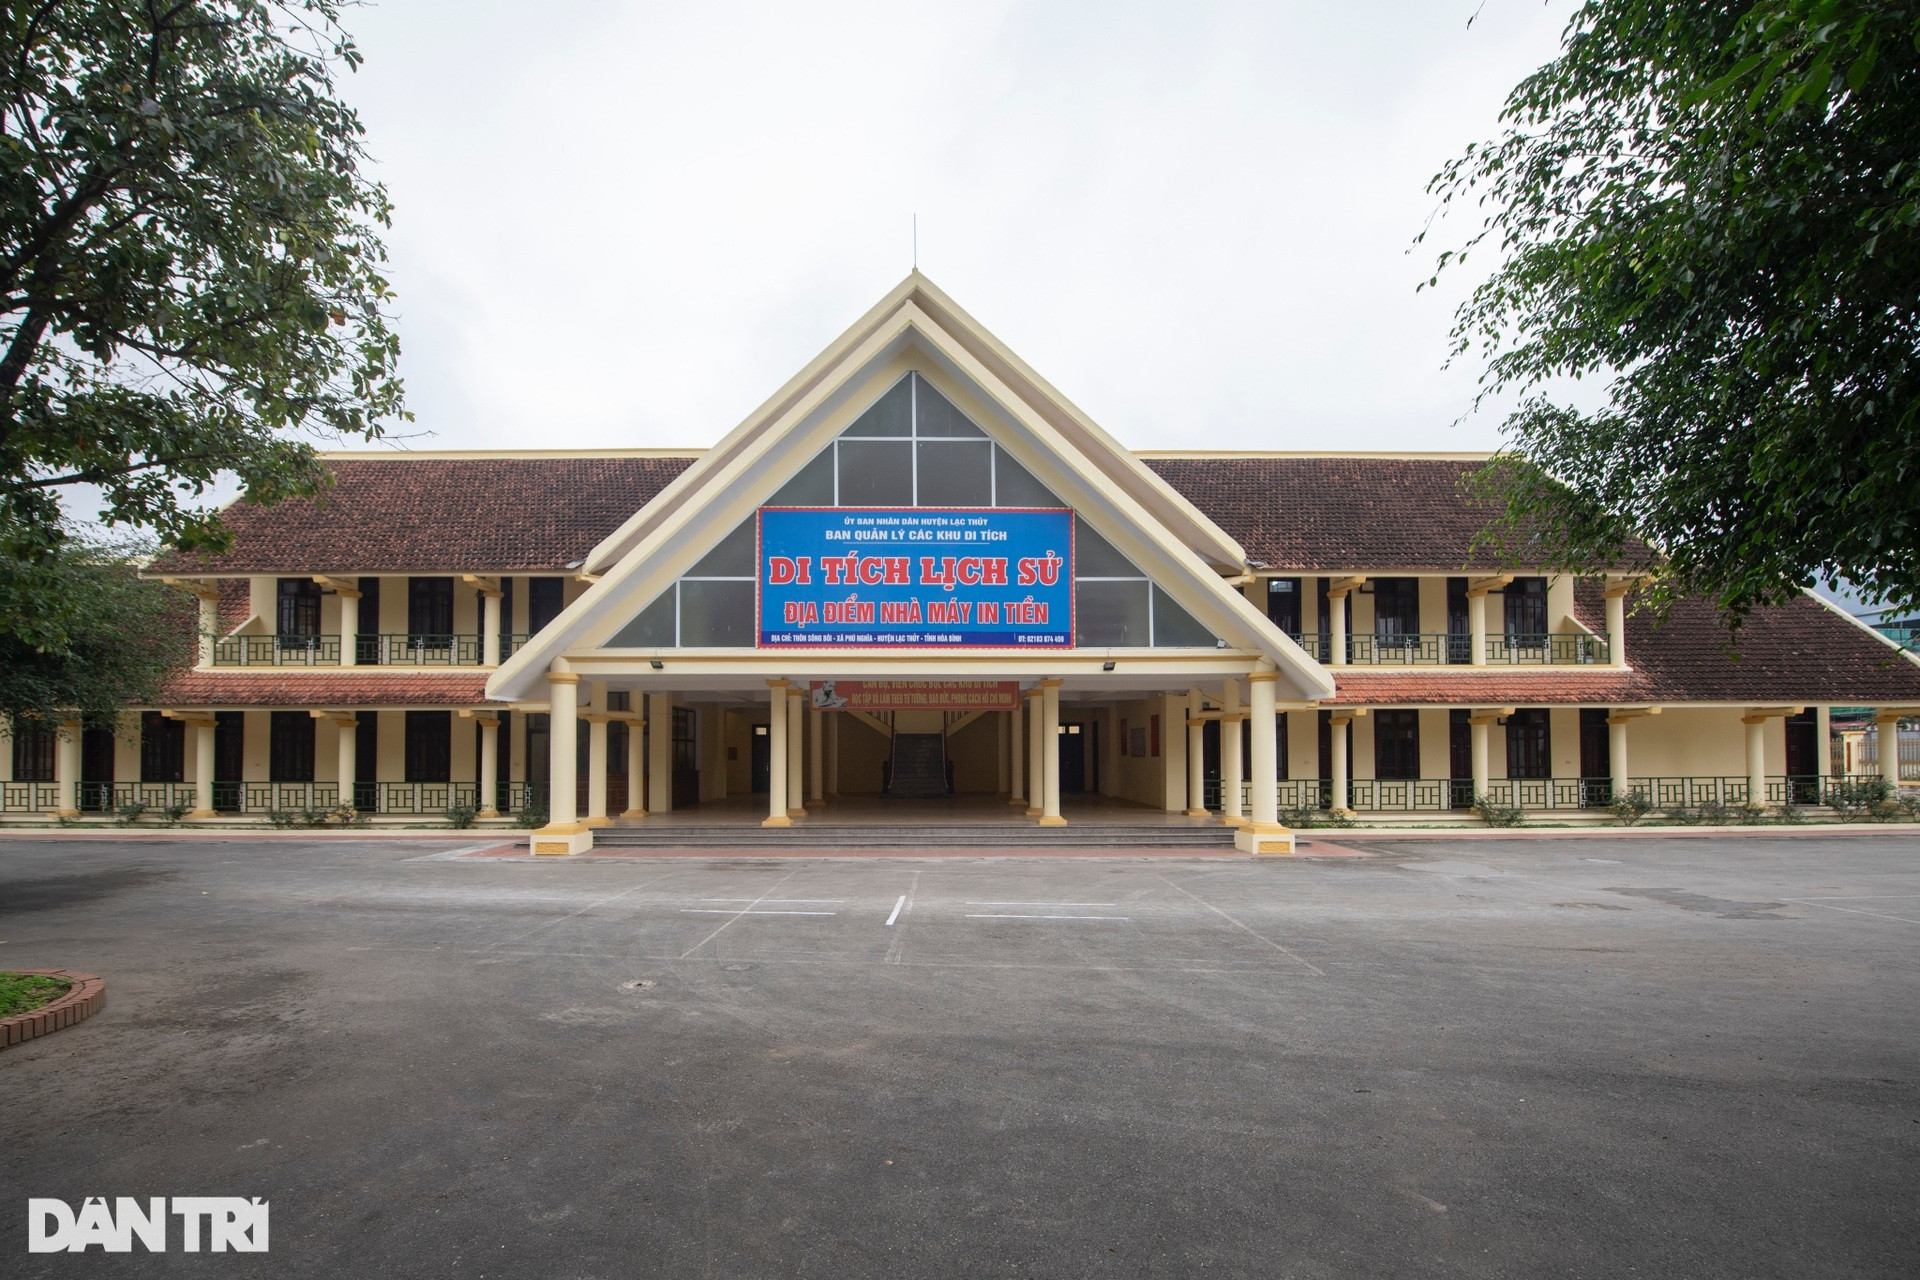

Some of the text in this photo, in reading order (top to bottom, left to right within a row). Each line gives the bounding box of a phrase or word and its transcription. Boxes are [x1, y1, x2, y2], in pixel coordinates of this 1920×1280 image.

[844, 516, 988, 527] ỦY BAN NHÂN DÂN HUYỆN LẠC THỦY
[825, 527, 1007, 541] BAN QUẢN LÝ CÁC KHU DI TÍCH
[769, 550, 1063, 591] DI TÍCH LỊCH SỬ
[784, 593, 1049, 628] ĐỊA ĐIỂM NHÀ MÁY IN TIỀN
[877, 633, 895, 643] HUYỆN
[895, 634, 906, 643] LẠC
